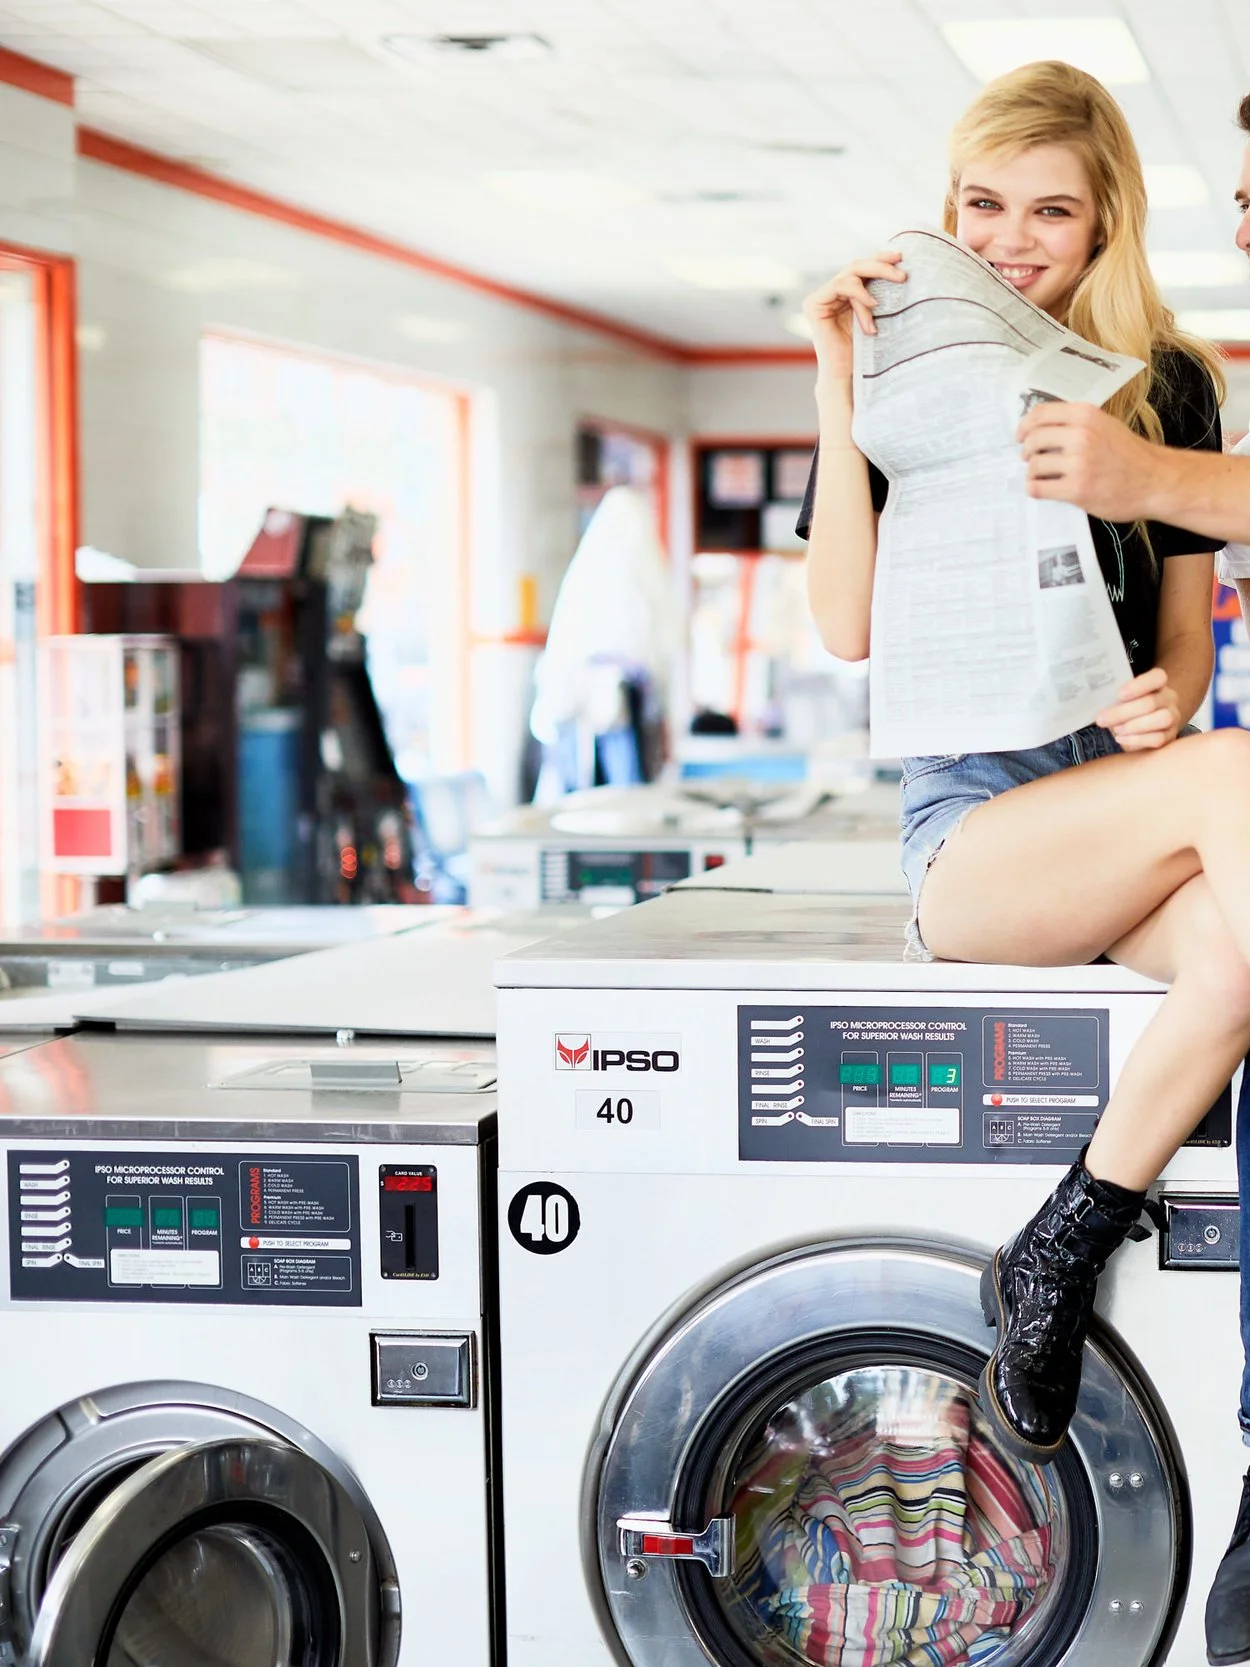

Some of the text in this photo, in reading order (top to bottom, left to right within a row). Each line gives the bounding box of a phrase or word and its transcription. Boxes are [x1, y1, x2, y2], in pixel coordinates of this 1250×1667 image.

[830, 1021, 967, 1030] IPSO MICROPROCESSOR CONTROL
[843, 1031, 955, 1040] FOR SUPERIOR WASH RESULTS
[592, 1049, 680, 1072] IPSO
[946, 1068, 957, 1084] 3
[596, 1097, 633, 1124] 40
[95, 1165, 224, 1175] IPSO MICROPROCESSOR CONTROL
[107, 1175, 213, 1185] FOR SUPERIOR WASH RESULTS
[250, 1167, 261, 1224] PROGRAMS
[520, 1194, 569, 1243] 40
